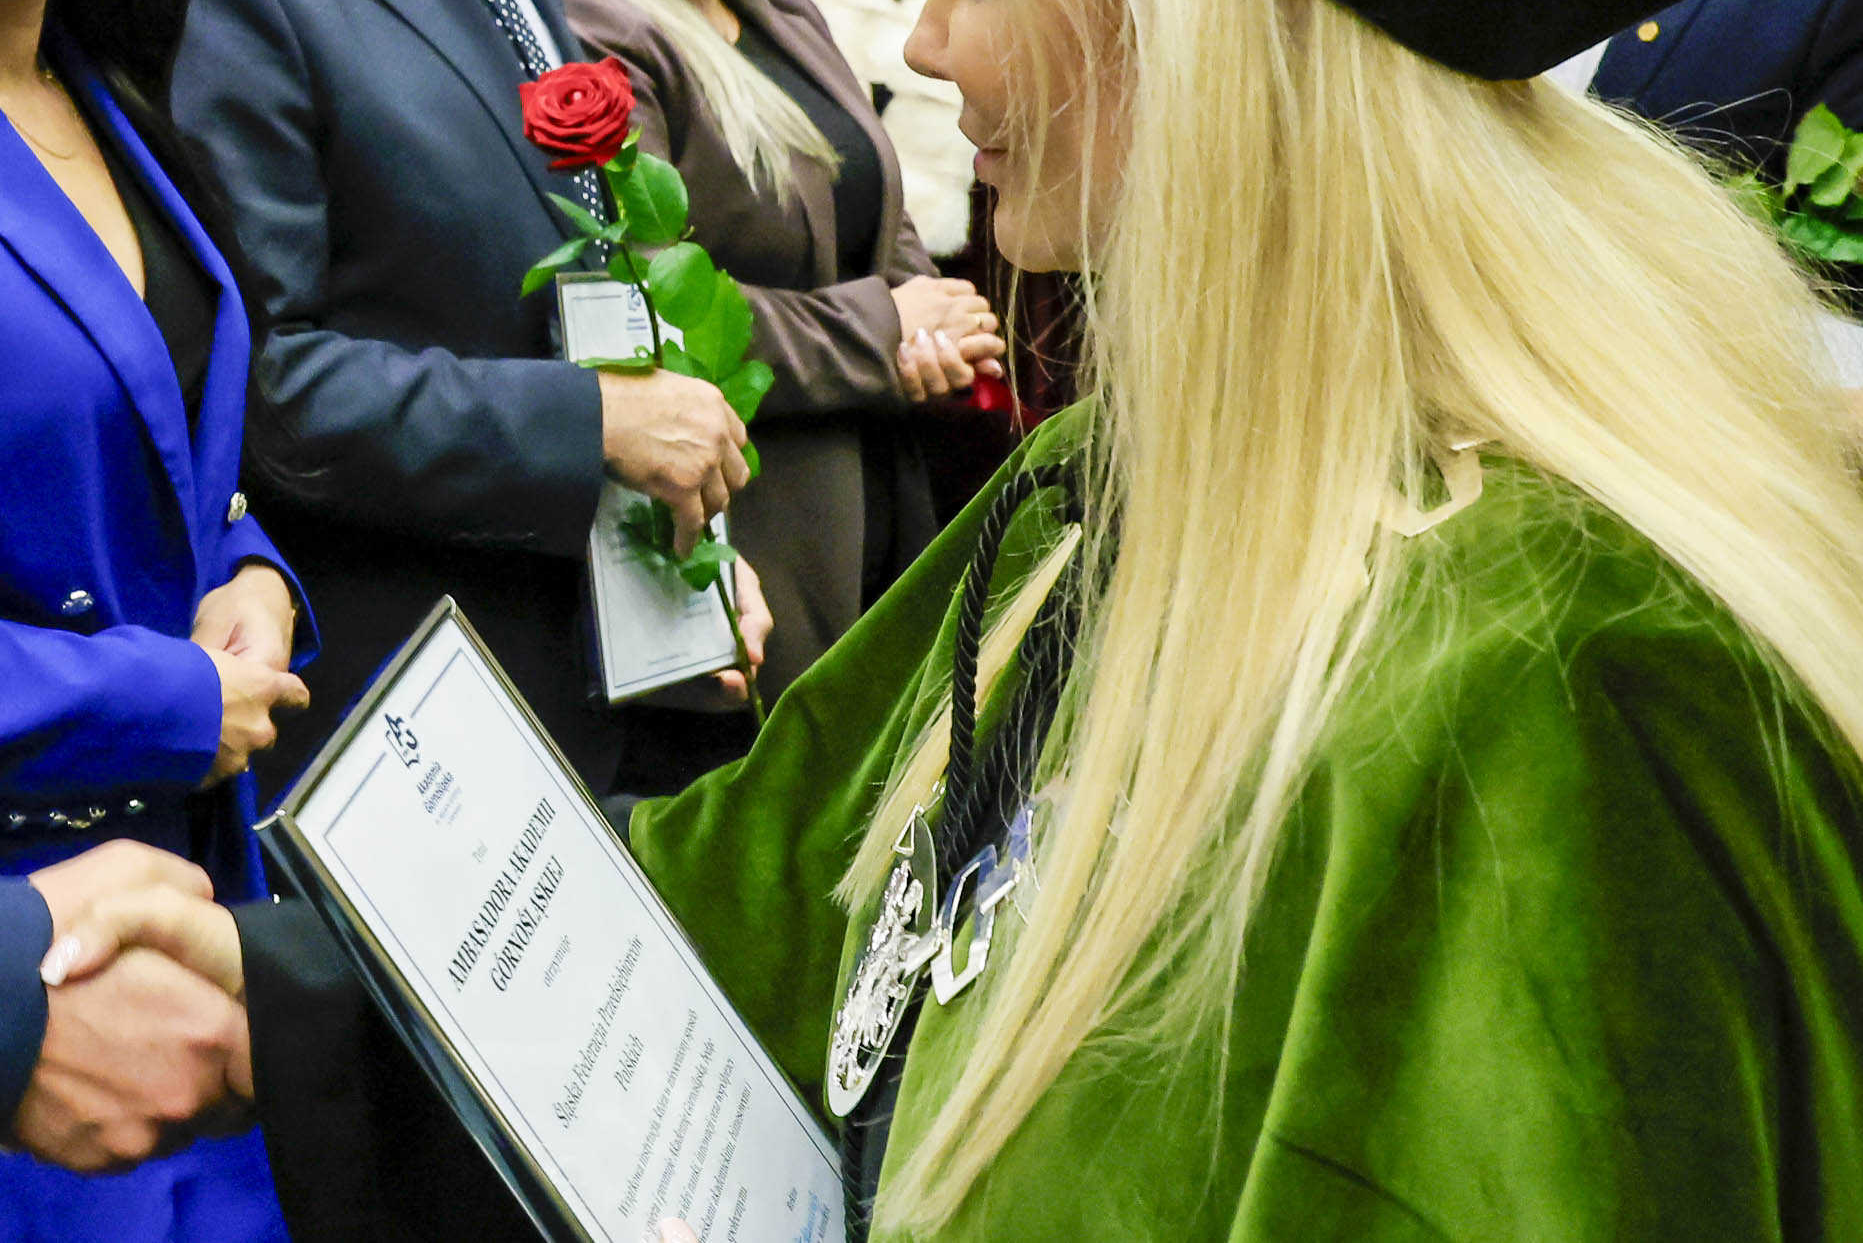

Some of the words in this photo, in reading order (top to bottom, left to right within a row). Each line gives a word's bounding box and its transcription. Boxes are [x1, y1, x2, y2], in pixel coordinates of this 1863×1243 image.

[448, 871, 517, 992] AMBASADORA
[510, 798, 555, 880] AKADEMII
[491, 855, 565, 992] GÓRNOŚLĄSKIEJ
[544, 935, 571, 987] otrzymuje
[553, 1082, 583, 1129] Śląska
[573, 1022, 608, 1085] Federacja
[598, 935, 643, 1027] Przedsiębiorców
[614, 1034, 644, 1092] Polskich
